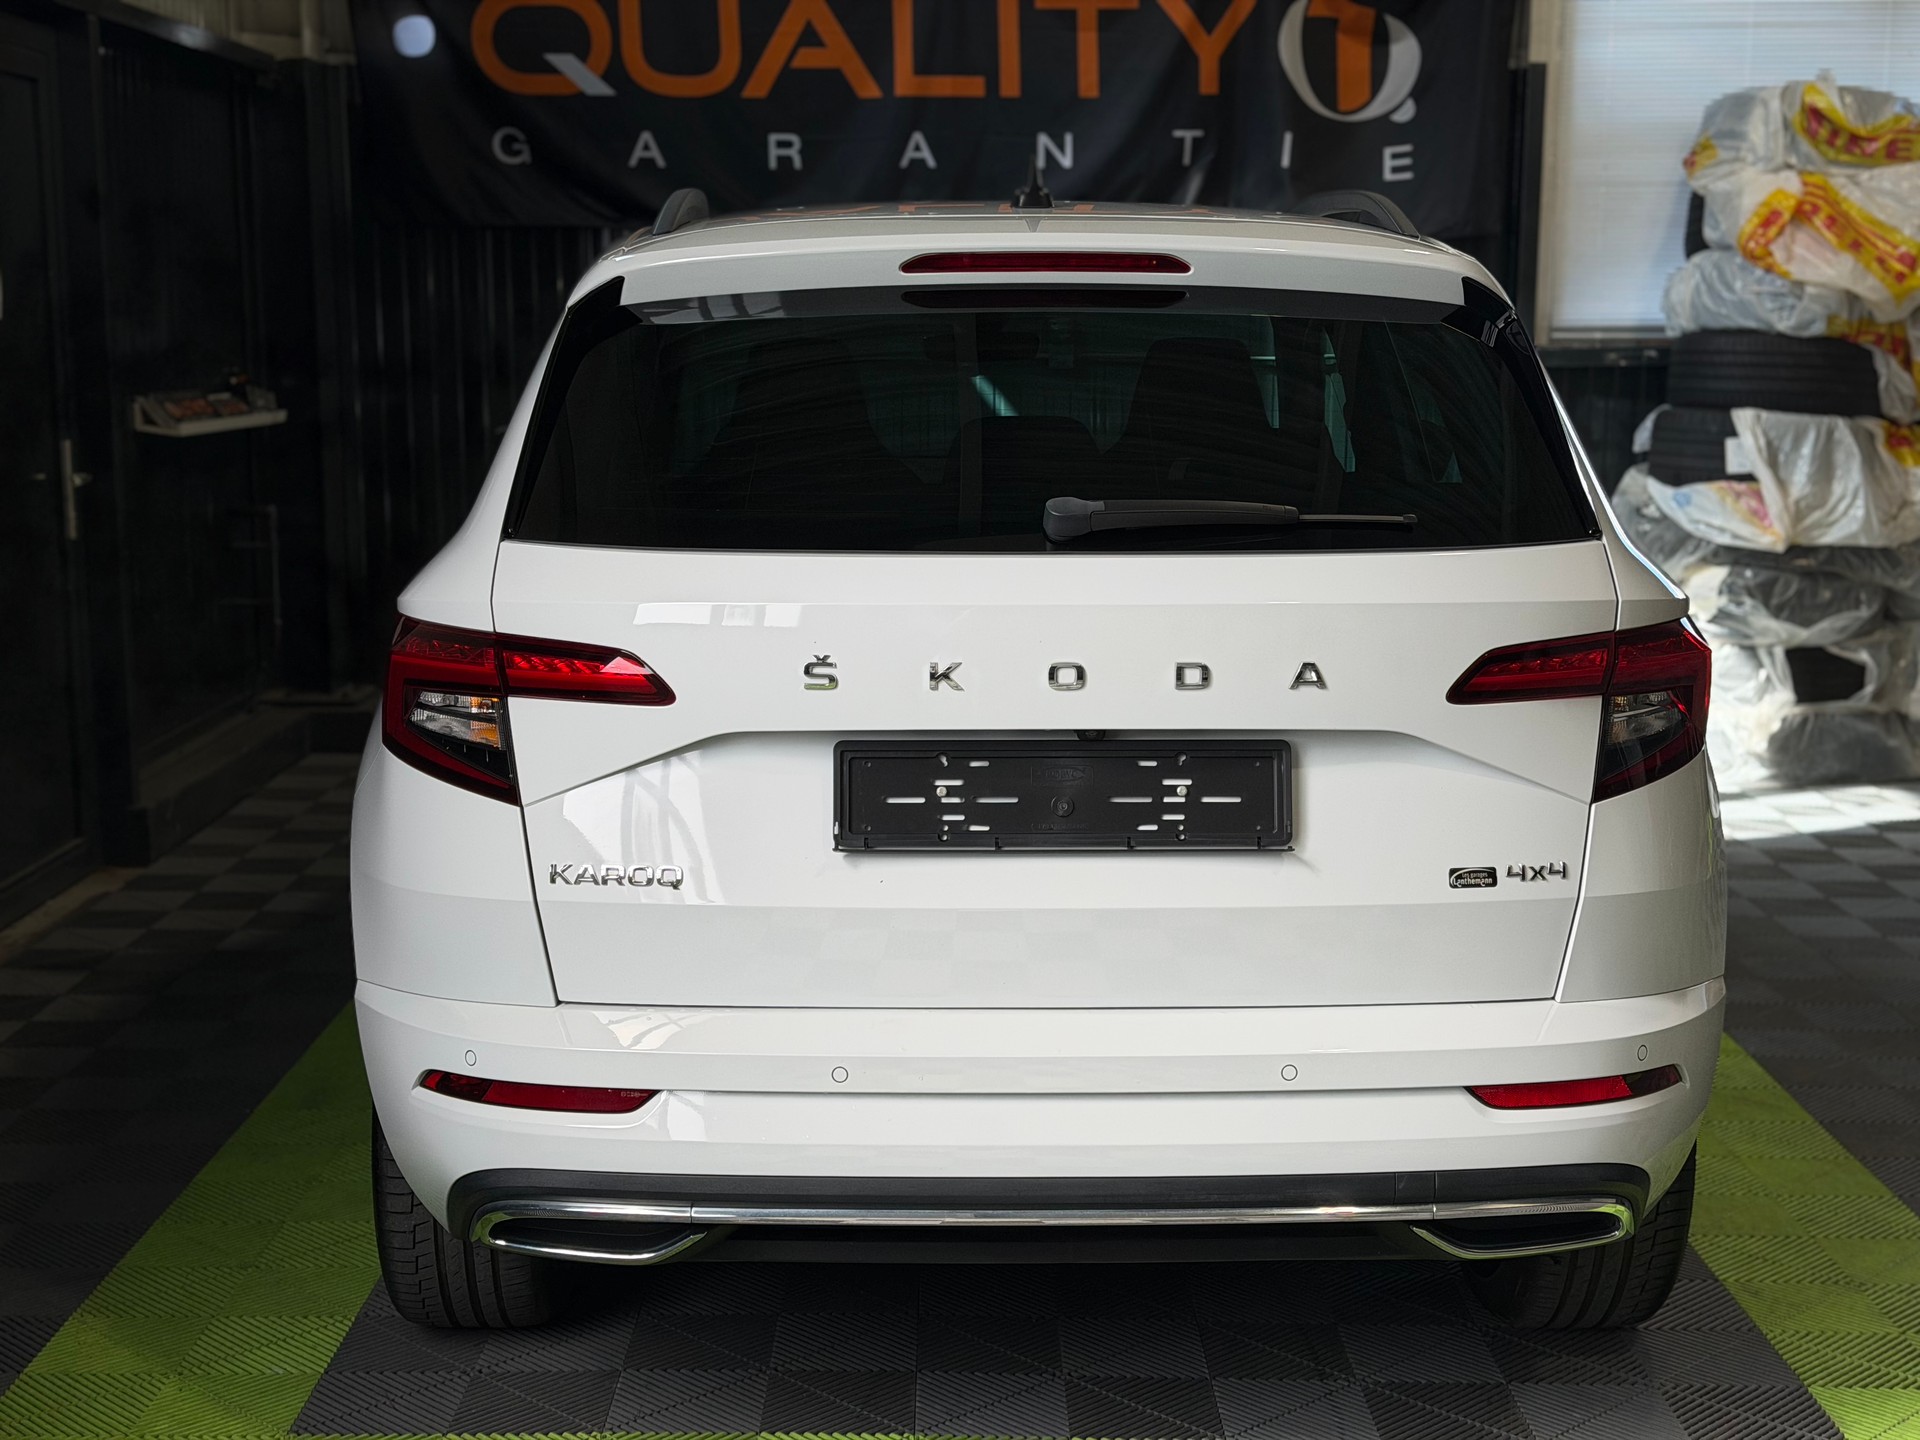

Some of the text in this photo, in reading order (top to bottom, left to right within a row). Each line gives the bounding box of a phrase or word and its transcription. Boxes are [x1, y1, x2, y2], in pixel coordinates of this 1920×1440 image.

[471, 0, 1257, 97] QUALITY
[491, 126, 1415, 182] GARANTIE
[803, 655, 1328, 691] ŠKODA
[549, 863, 684, 890] KAROQ
[1506, 861, 1567, 883] 4x4
